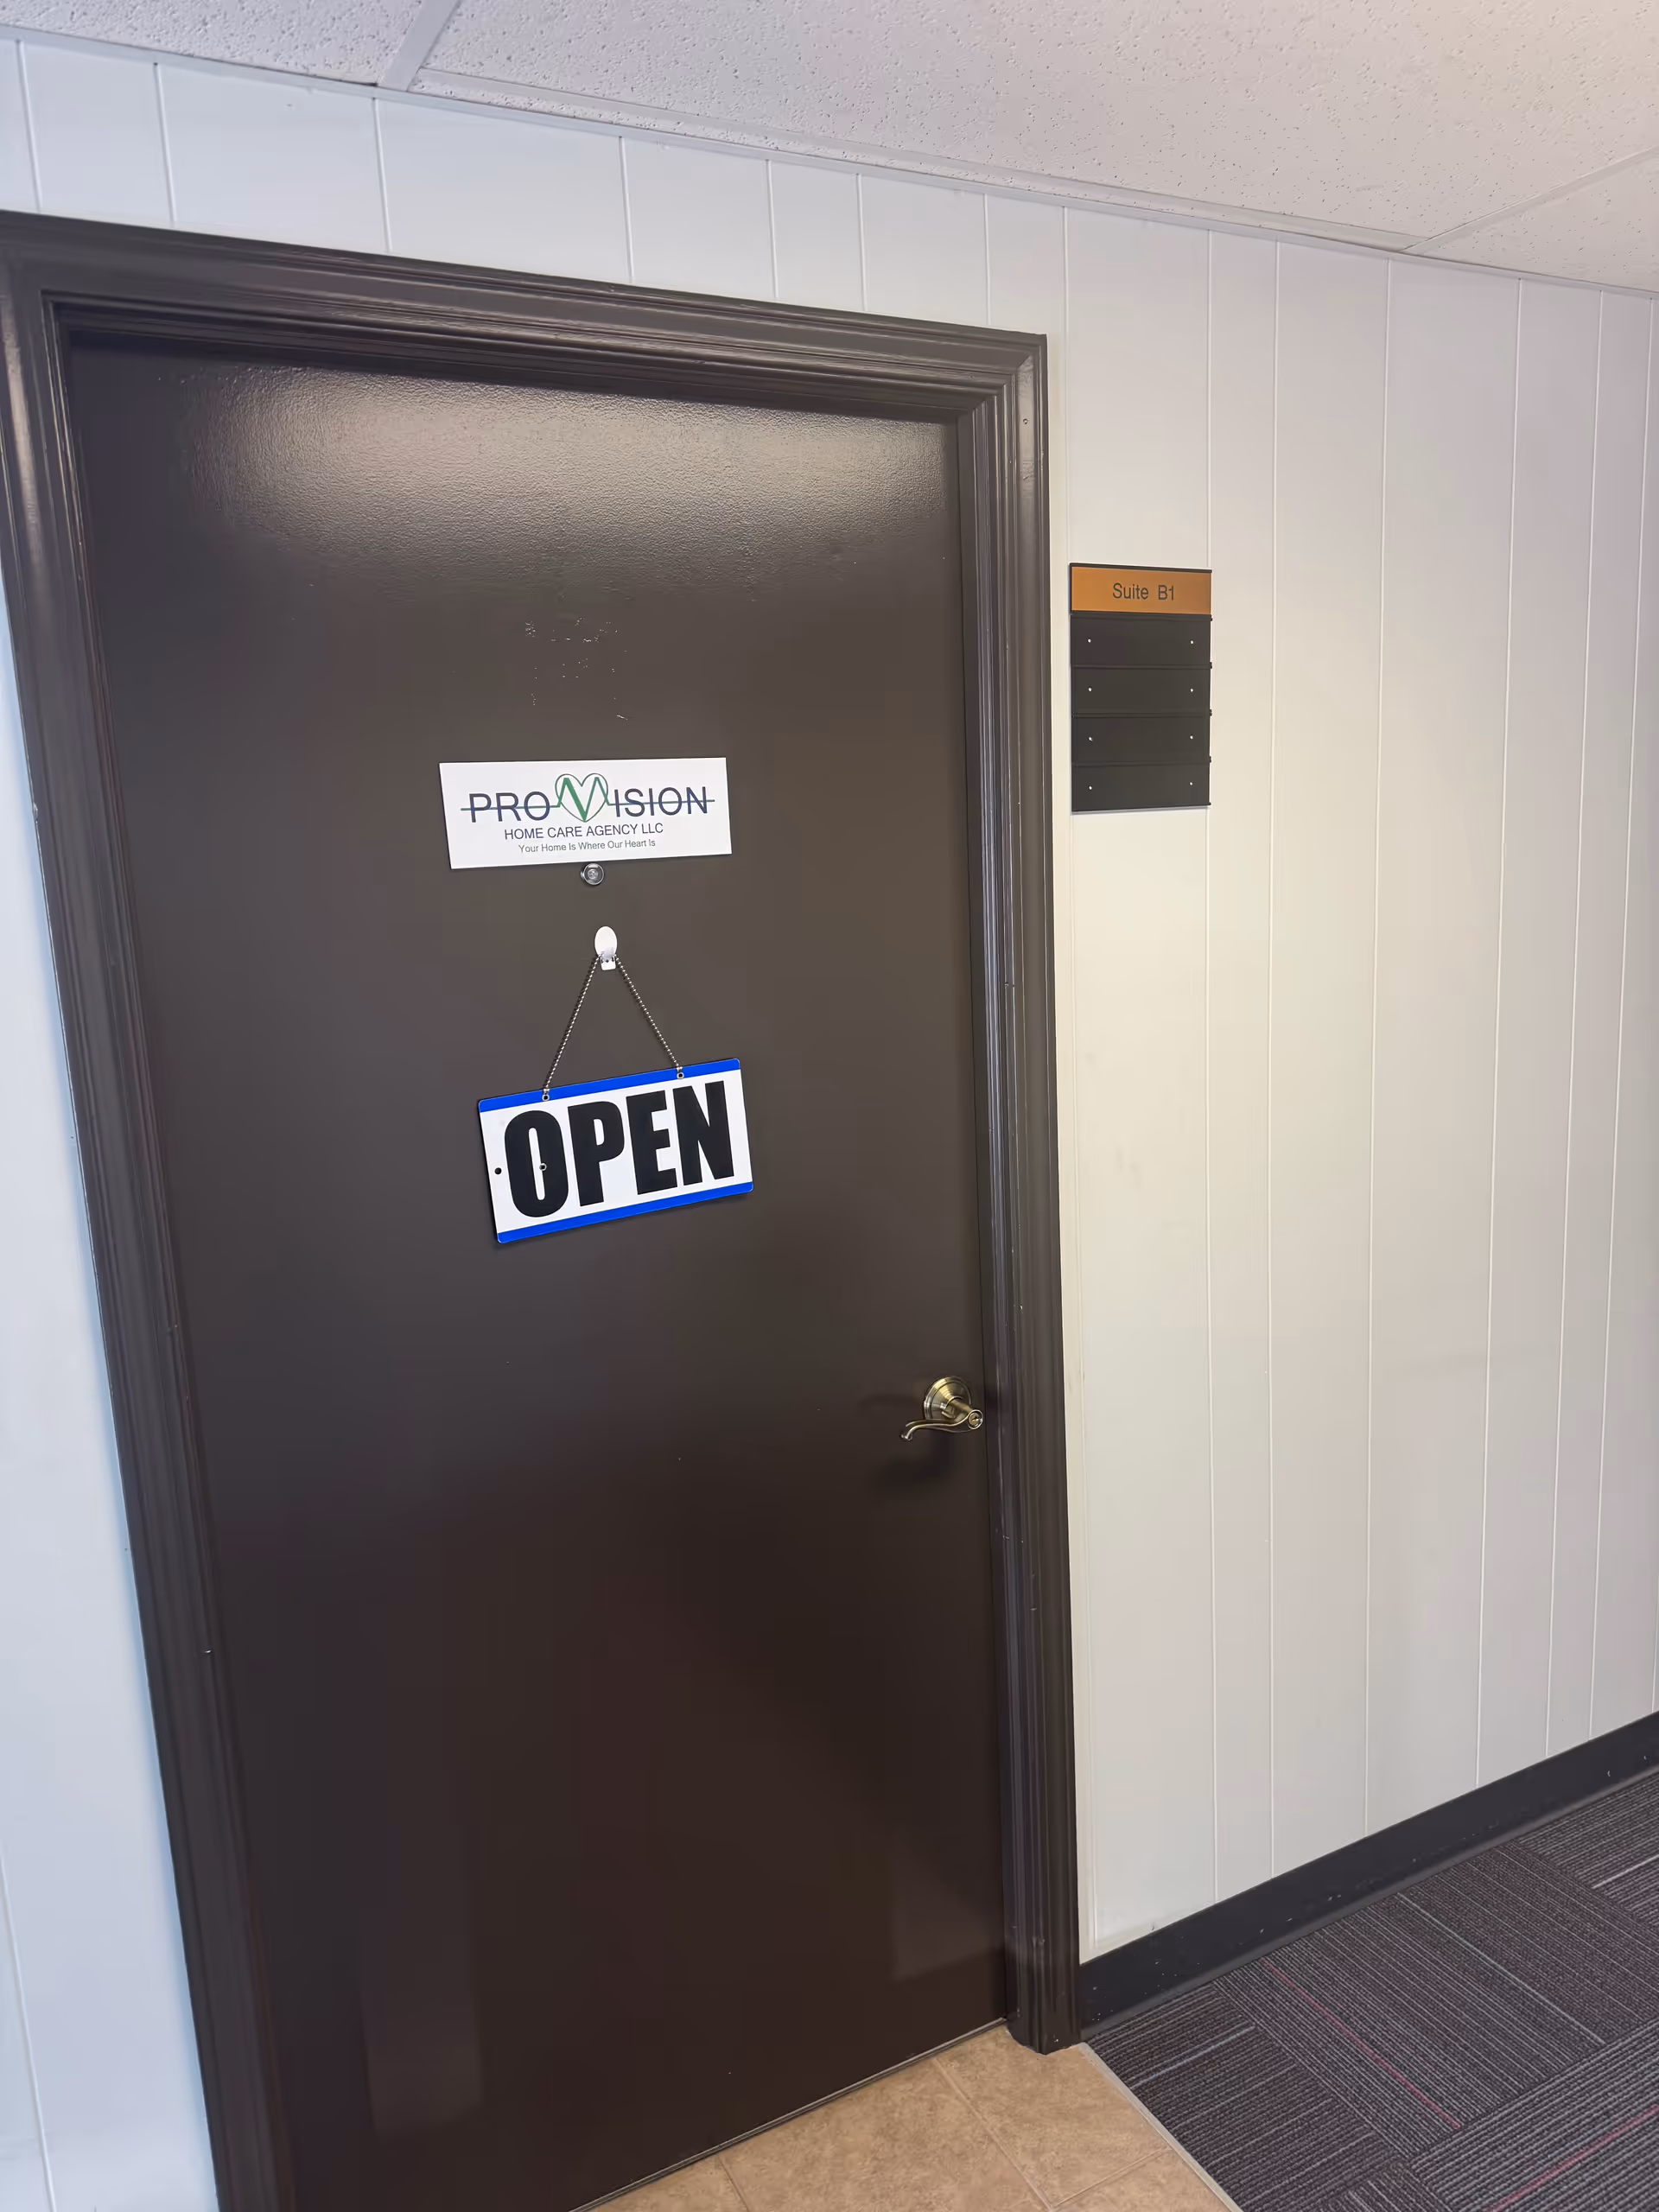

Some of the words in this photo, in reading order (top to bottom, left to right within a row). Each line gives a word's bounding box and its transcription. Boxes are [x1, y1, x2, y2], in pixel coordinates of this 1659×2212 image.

[1112, 582, 1149, 600] Suite
[1158, 584, 1175, 601] B1
[505, 827, 543, 840] HOME
[547, 826, 583, 838] CARE
[586, 823, 638, 837] AGENCY
[642, 823, 664, 834] LLC
[518, 843, 538, 854] Your
[541, 842, 566, 852] Home
[569, 842, 576, 851] Is
[577, 841, 606, 850] Where
[607, 840, 623, 849] Our
[625, 839, 647, 849] Heart
[649, 838, 656, 848] Is
[504, 1080, 734, 1218] OPEN
